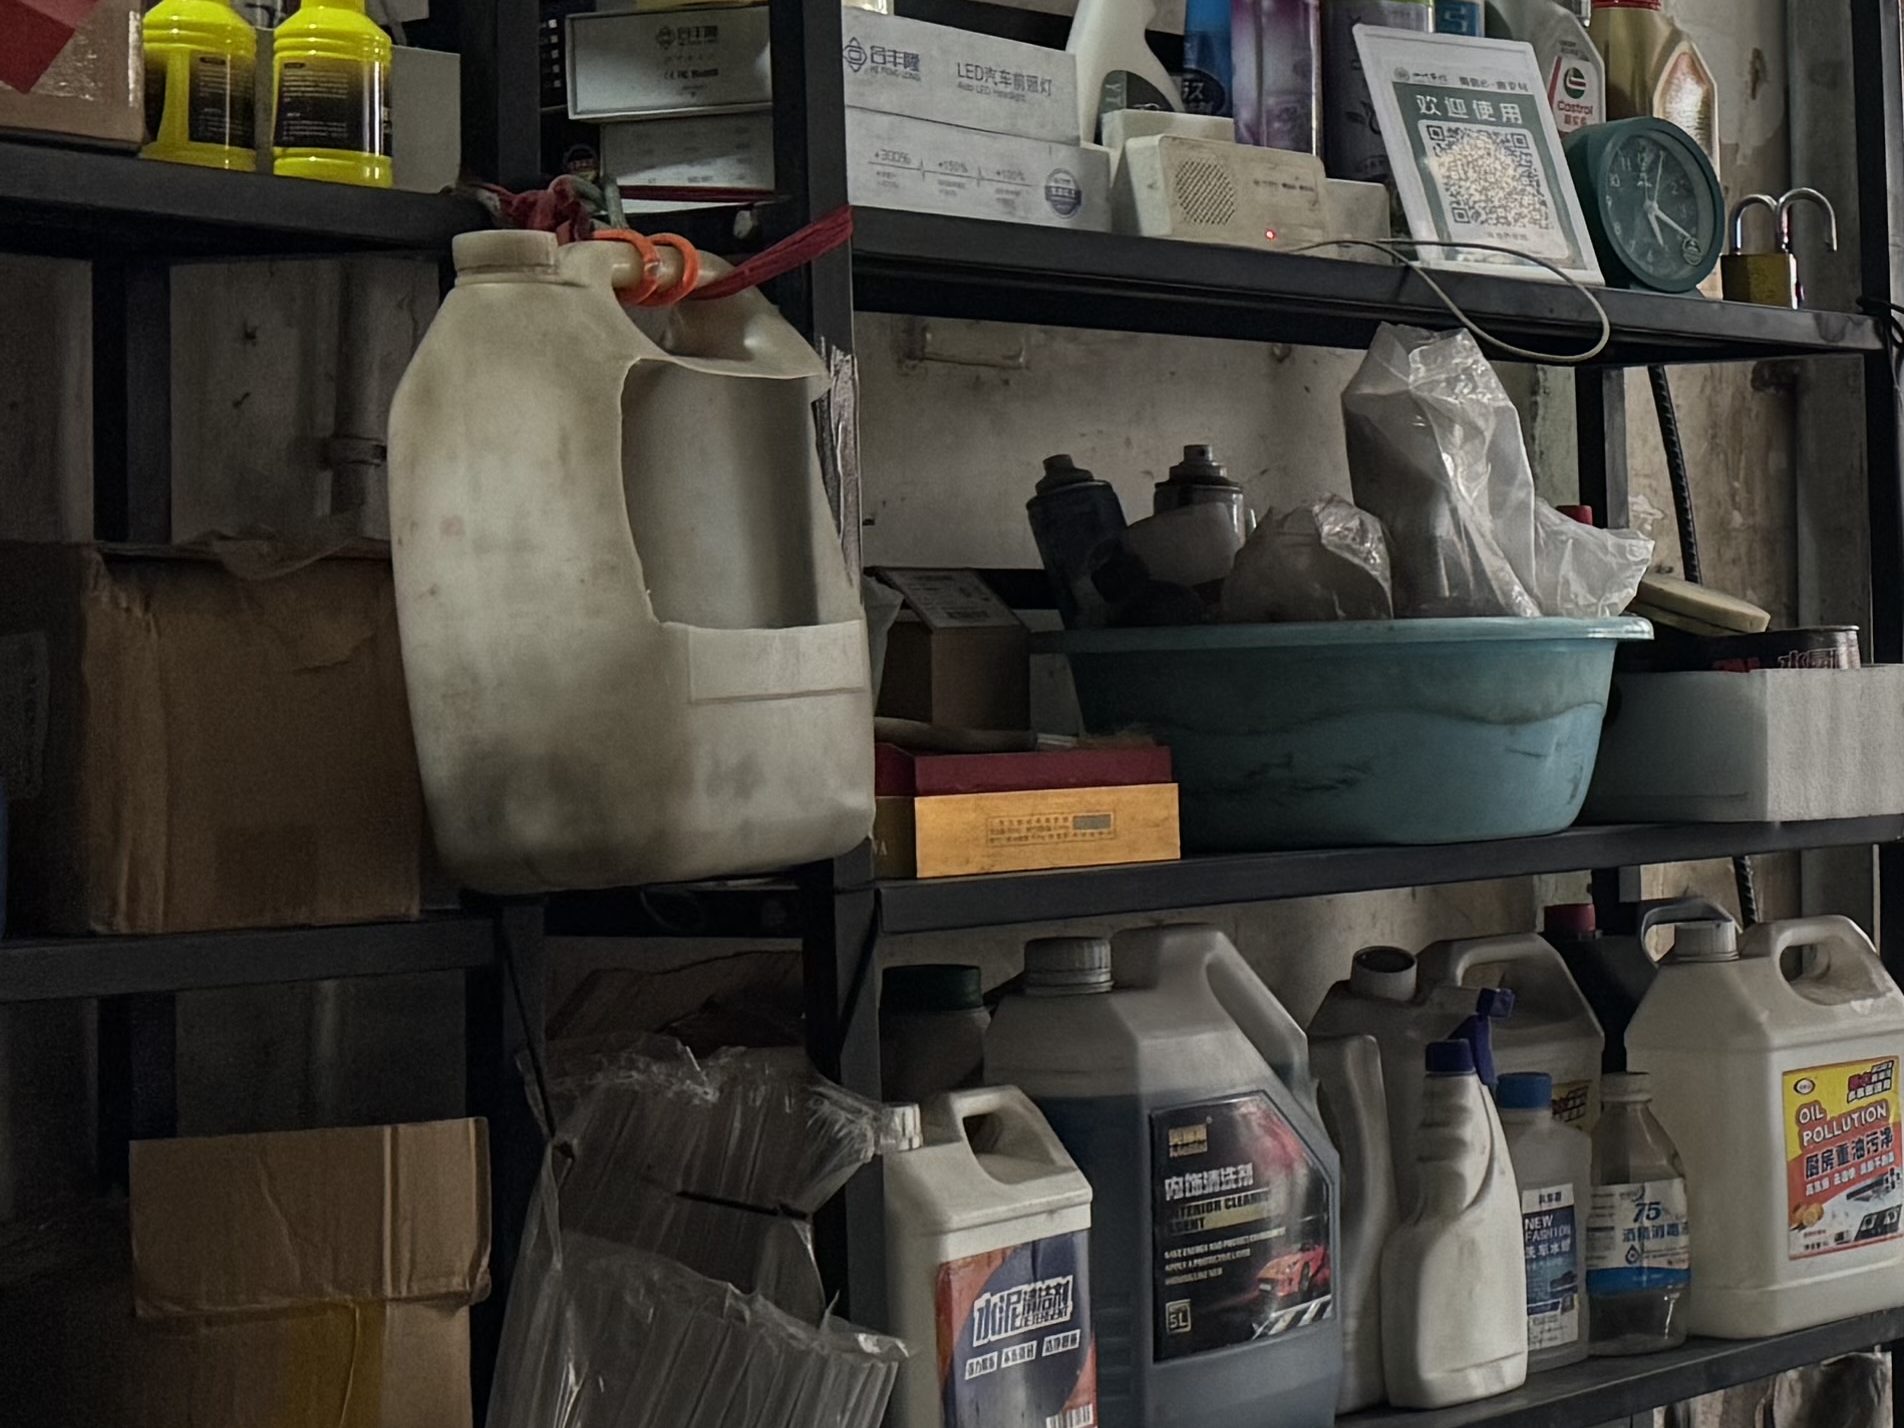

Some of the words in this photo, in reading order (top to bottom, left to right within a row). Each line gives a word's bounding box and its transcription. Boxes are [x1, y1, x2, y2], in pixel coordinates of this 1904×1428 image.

[1415, 93, 1524, 125] 欢迎使用
[1798, 1105, 1826, 1125] OIL
[1802, 1103, 1889, 1148] POLLUTION
[1524, 1214, 1554, 1231] NEW
[1632, 1201, 1662, 1224] 75
[1168, 1311, 1189, 1331] 5L
